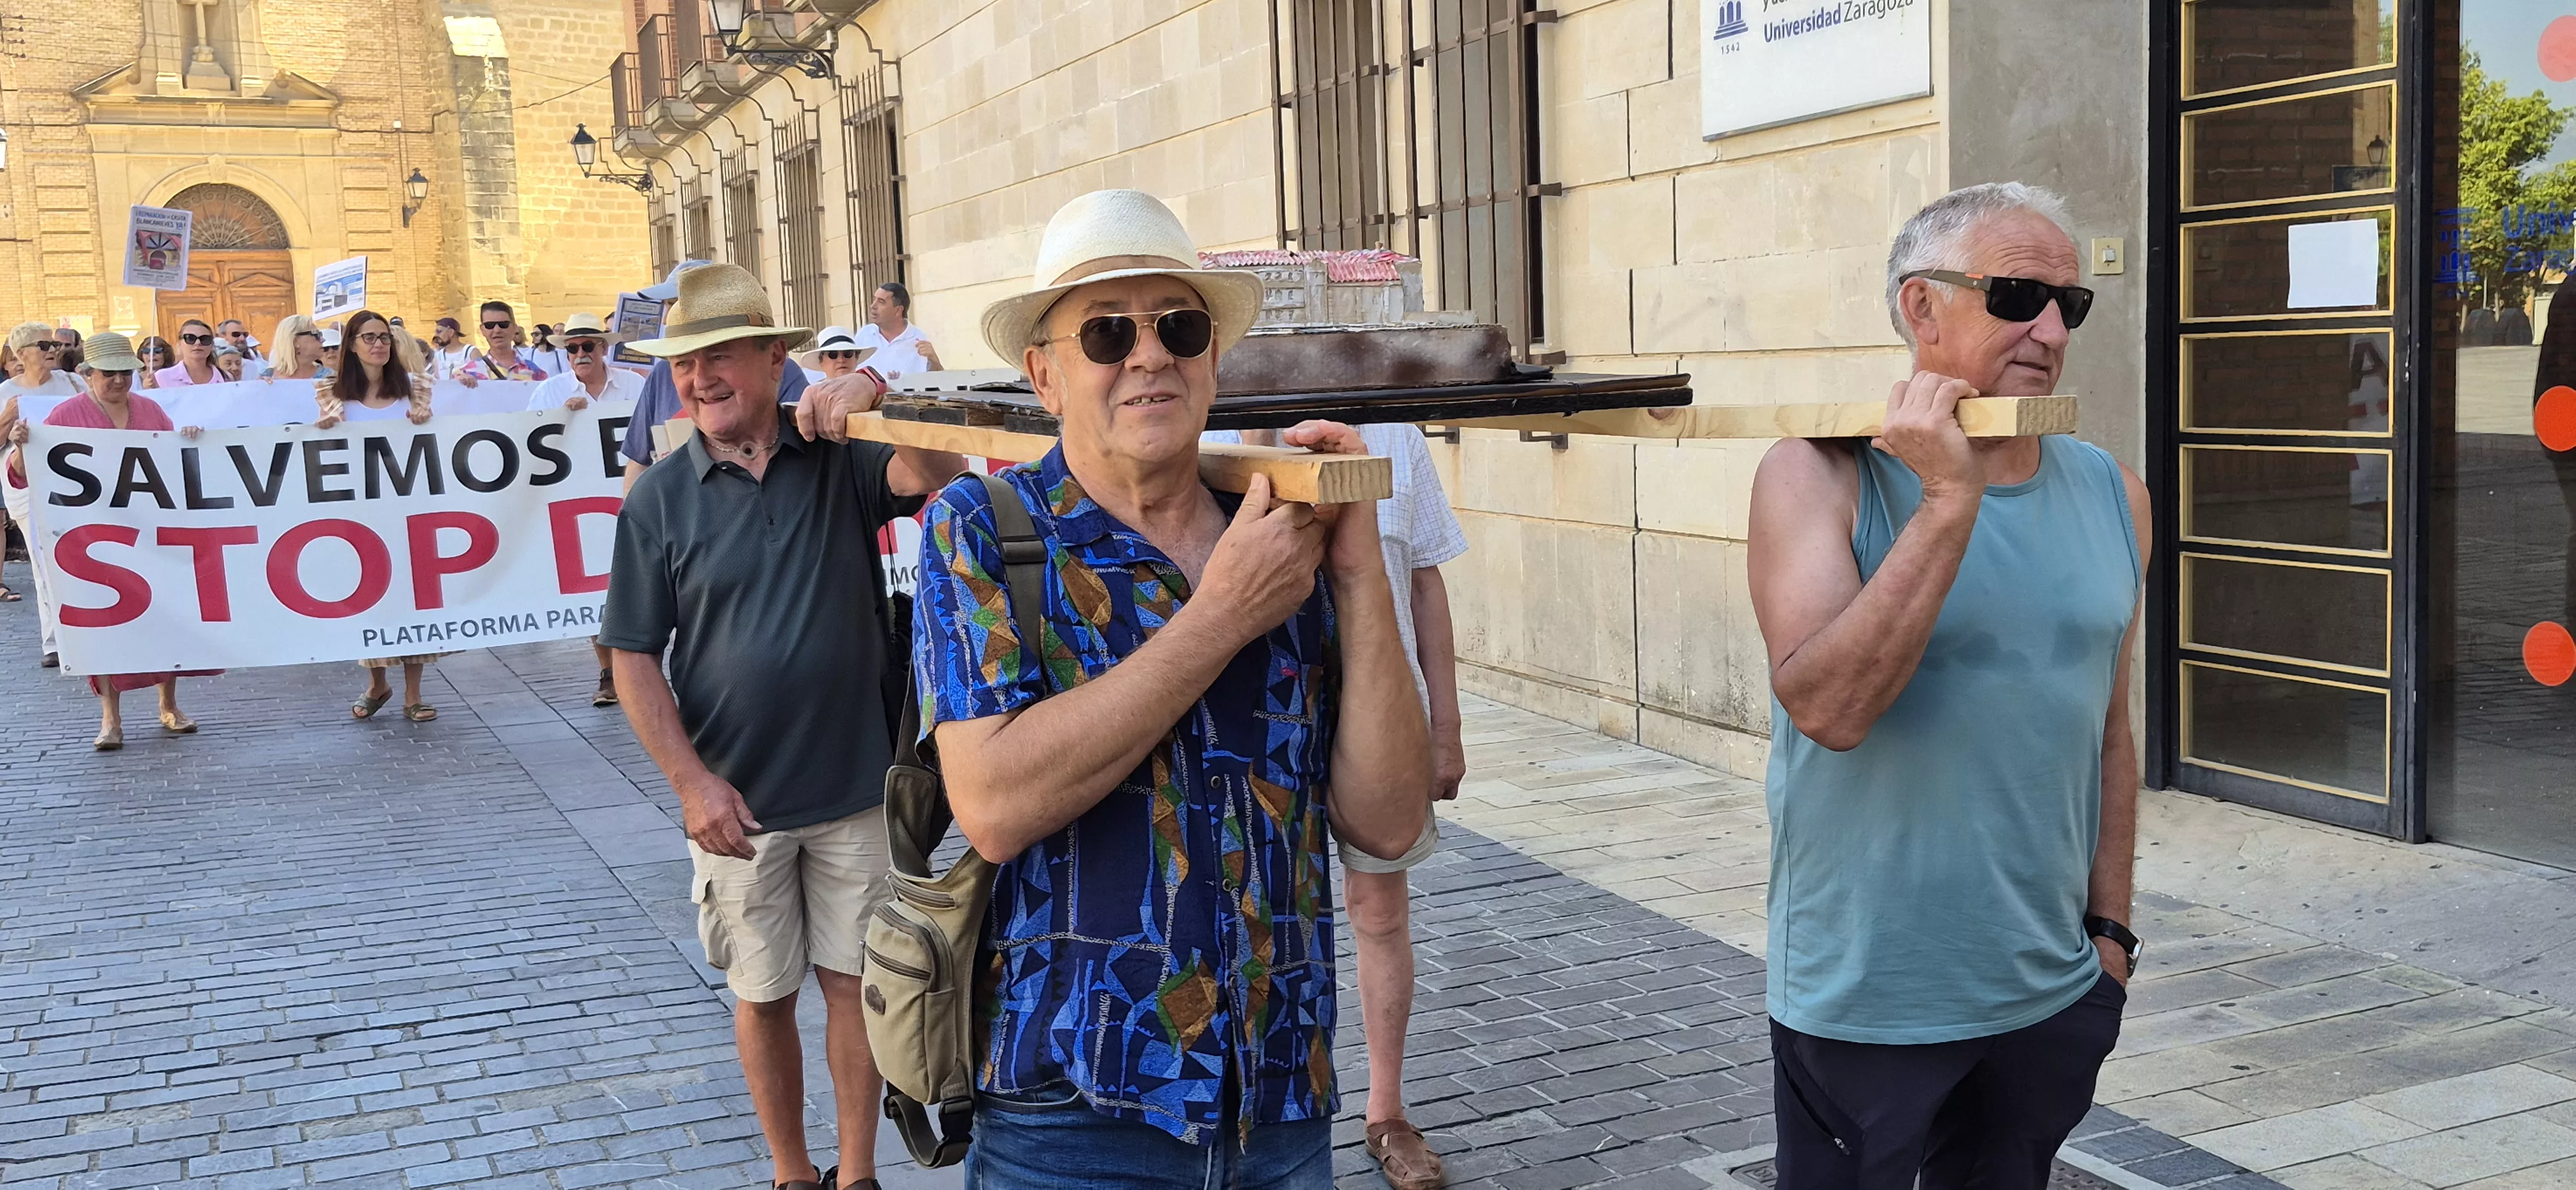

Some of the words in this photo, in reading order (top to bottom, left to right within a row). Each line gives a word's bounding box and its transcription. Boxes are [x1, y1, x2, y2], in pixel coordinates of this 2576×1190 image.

[1764, 2, 1841, 43] Universidad
[1721, 42, 1740, 55] 1542
[47, 423, 572, 510] SALVEMOS
[54, 511, 500, 627] STOP
[363, 613, 540, 647] PLATAFORMA
